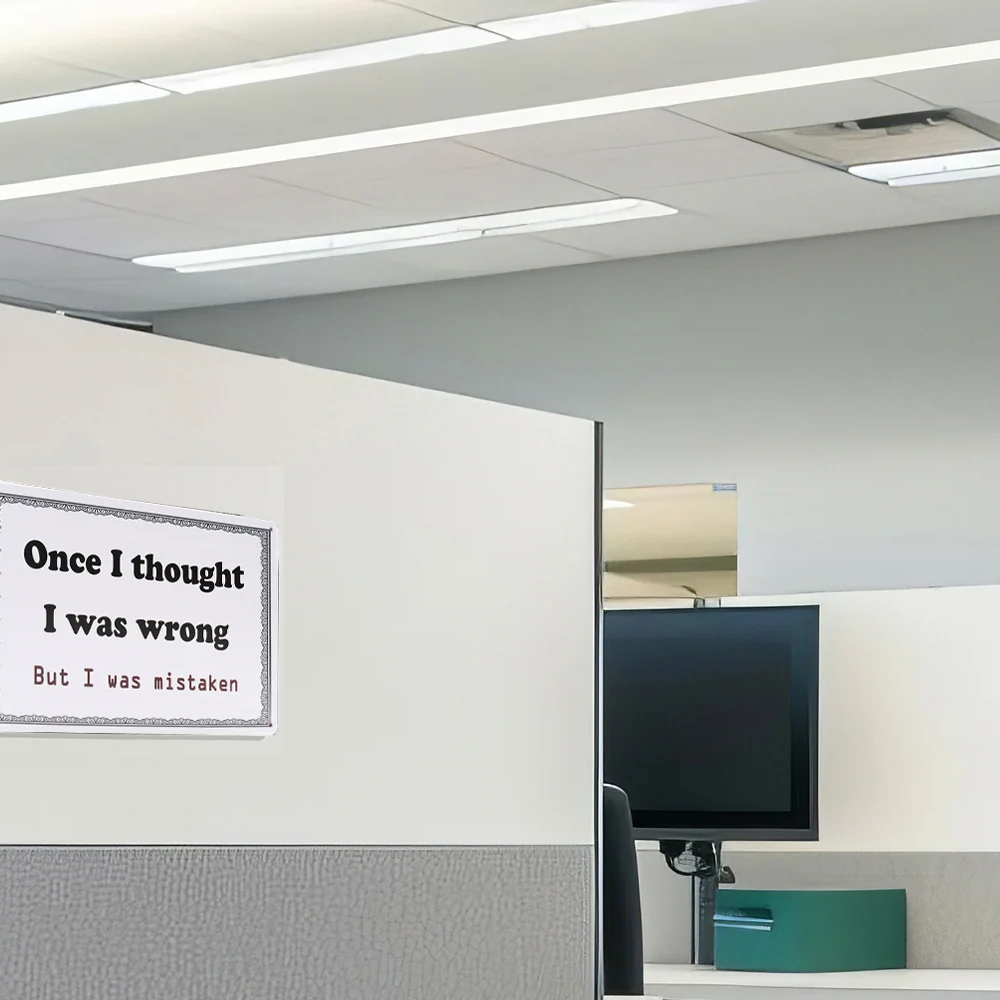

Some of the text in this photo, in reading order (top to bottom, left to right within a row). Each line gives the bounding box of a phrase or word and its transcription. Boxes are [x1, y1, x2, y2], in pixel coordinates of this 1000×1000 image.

[22, 539, 245, 593] Once I thought
[43, 603, 230, 651] I was wrong
[33, 665, 239, 693] But I was mistaken
